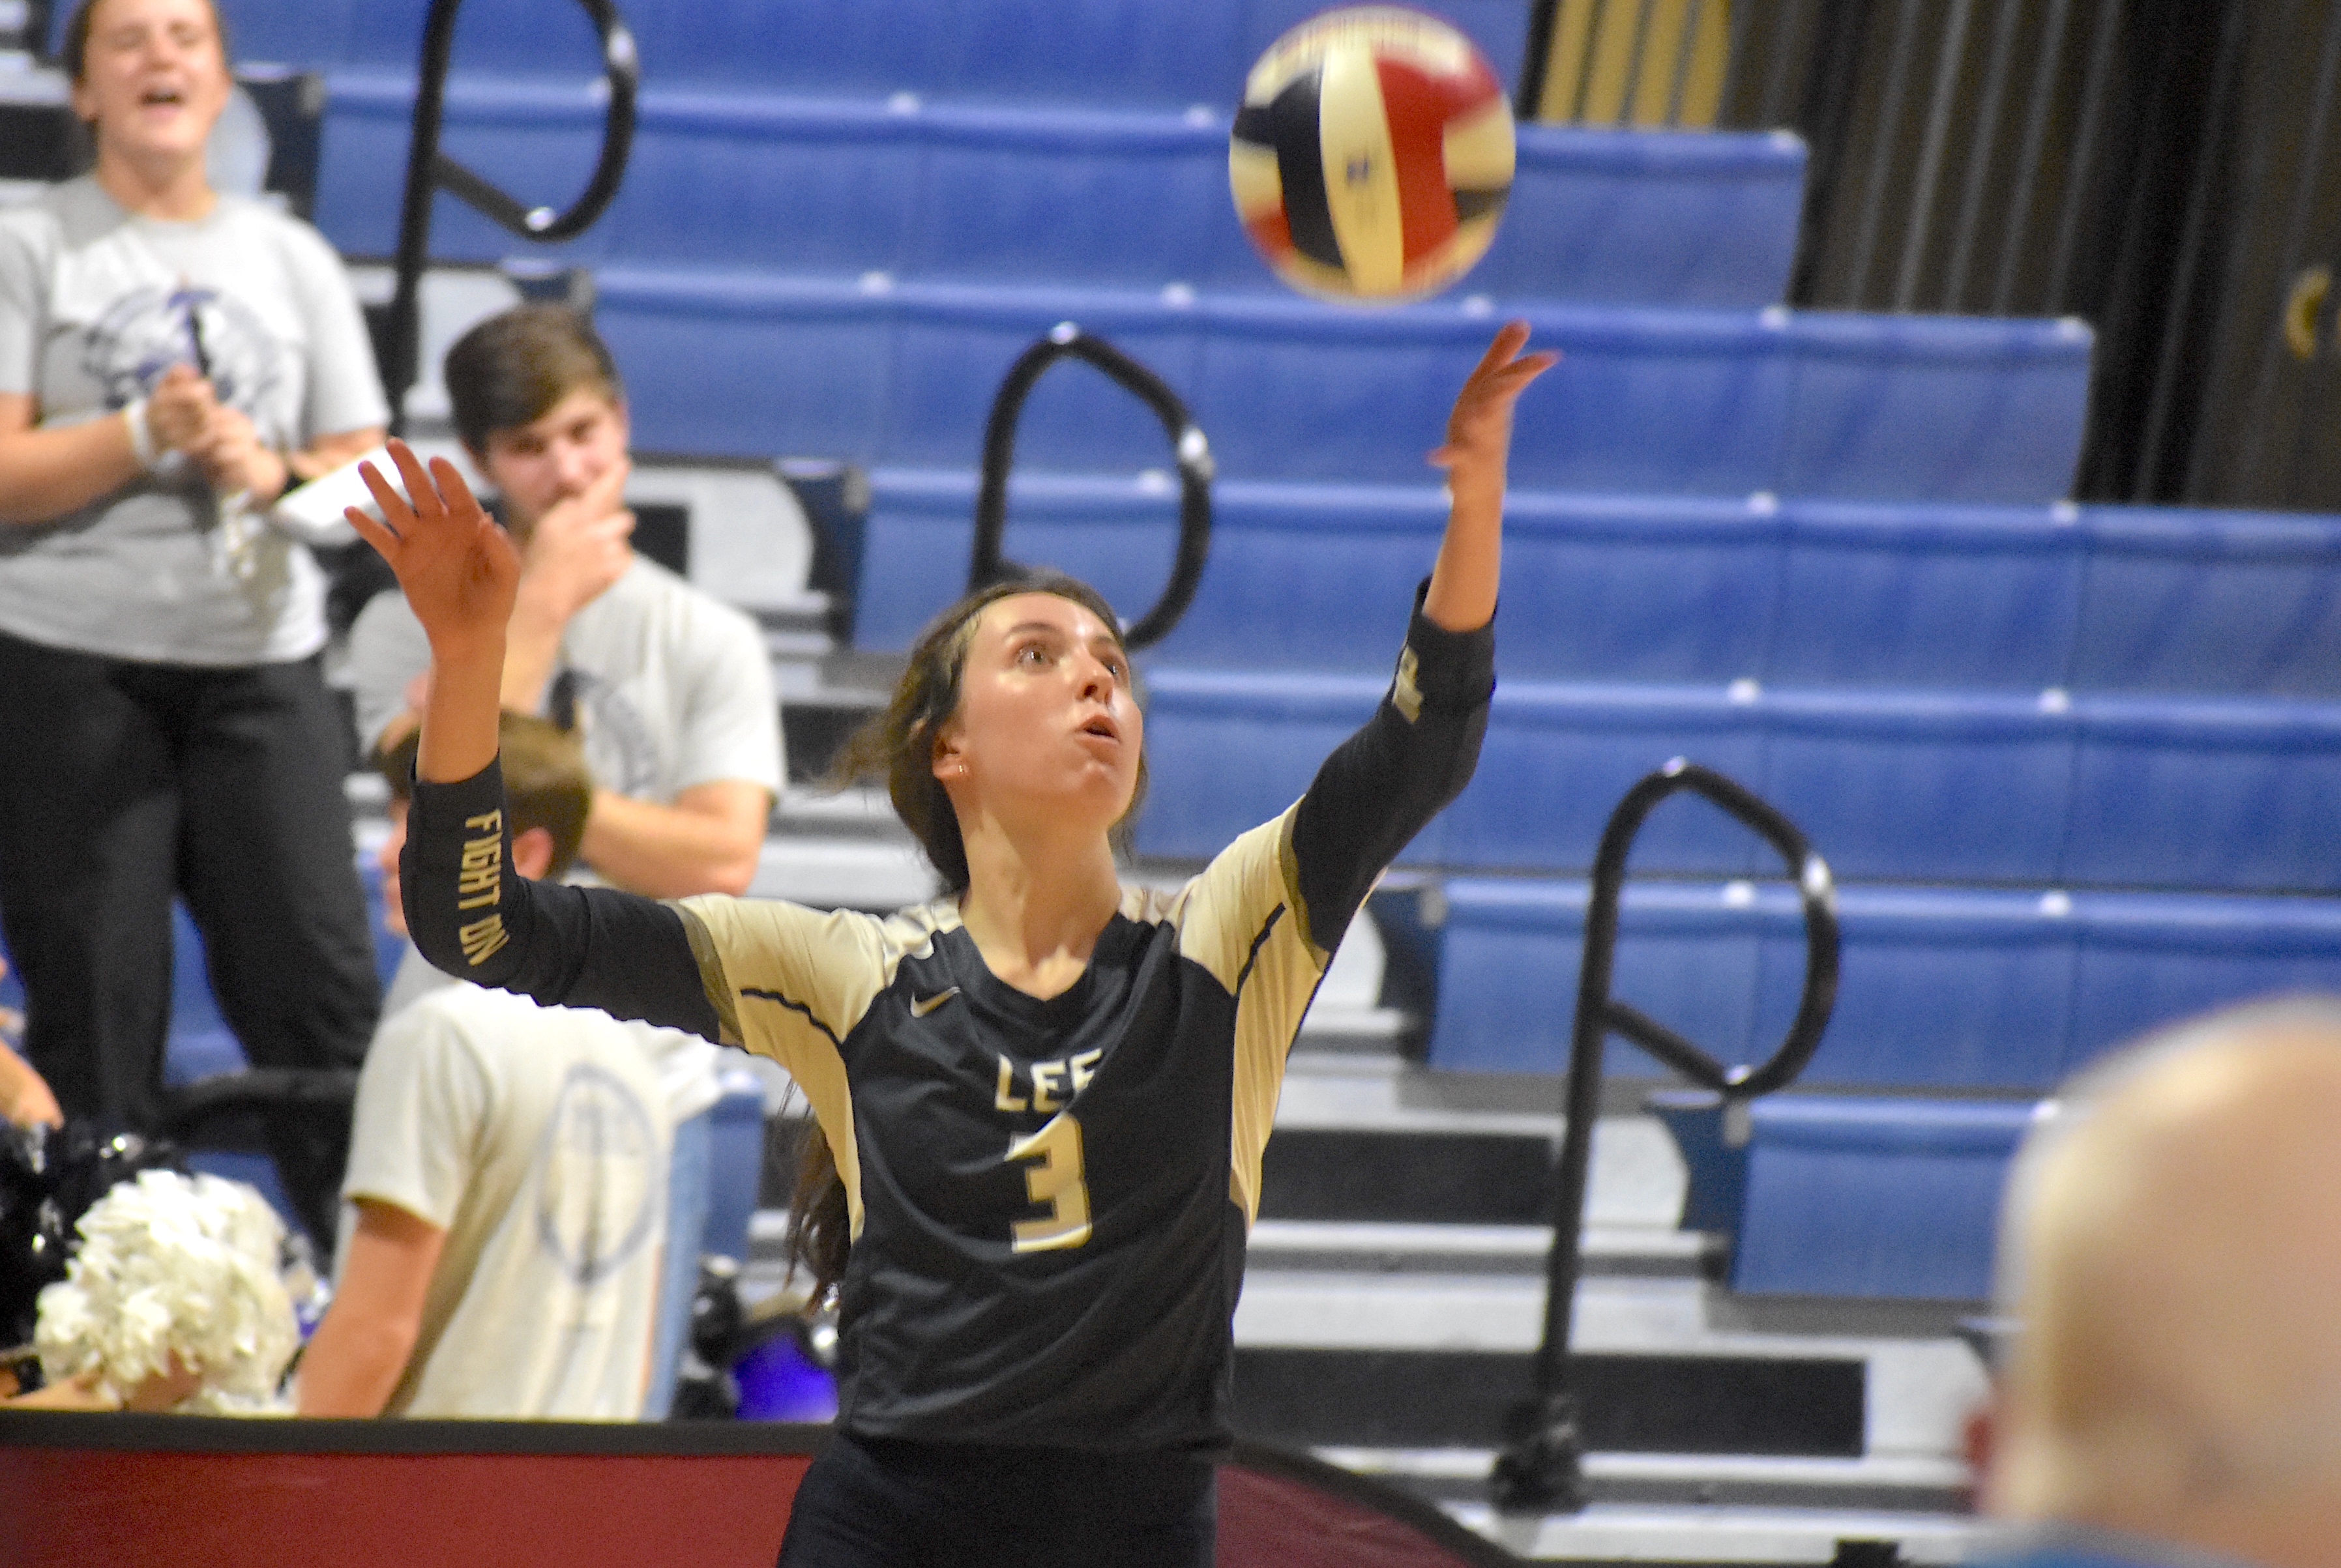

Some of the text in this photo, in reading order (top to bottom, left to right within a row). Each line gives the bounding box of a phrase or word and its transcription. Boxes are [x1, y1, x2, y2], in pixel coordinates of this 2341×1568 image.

[458, 808, 510, 967] FIGHT ON
[995, 1047, 1102, 1112] LEE
[1004, 1111, 1093, 1254] 3
